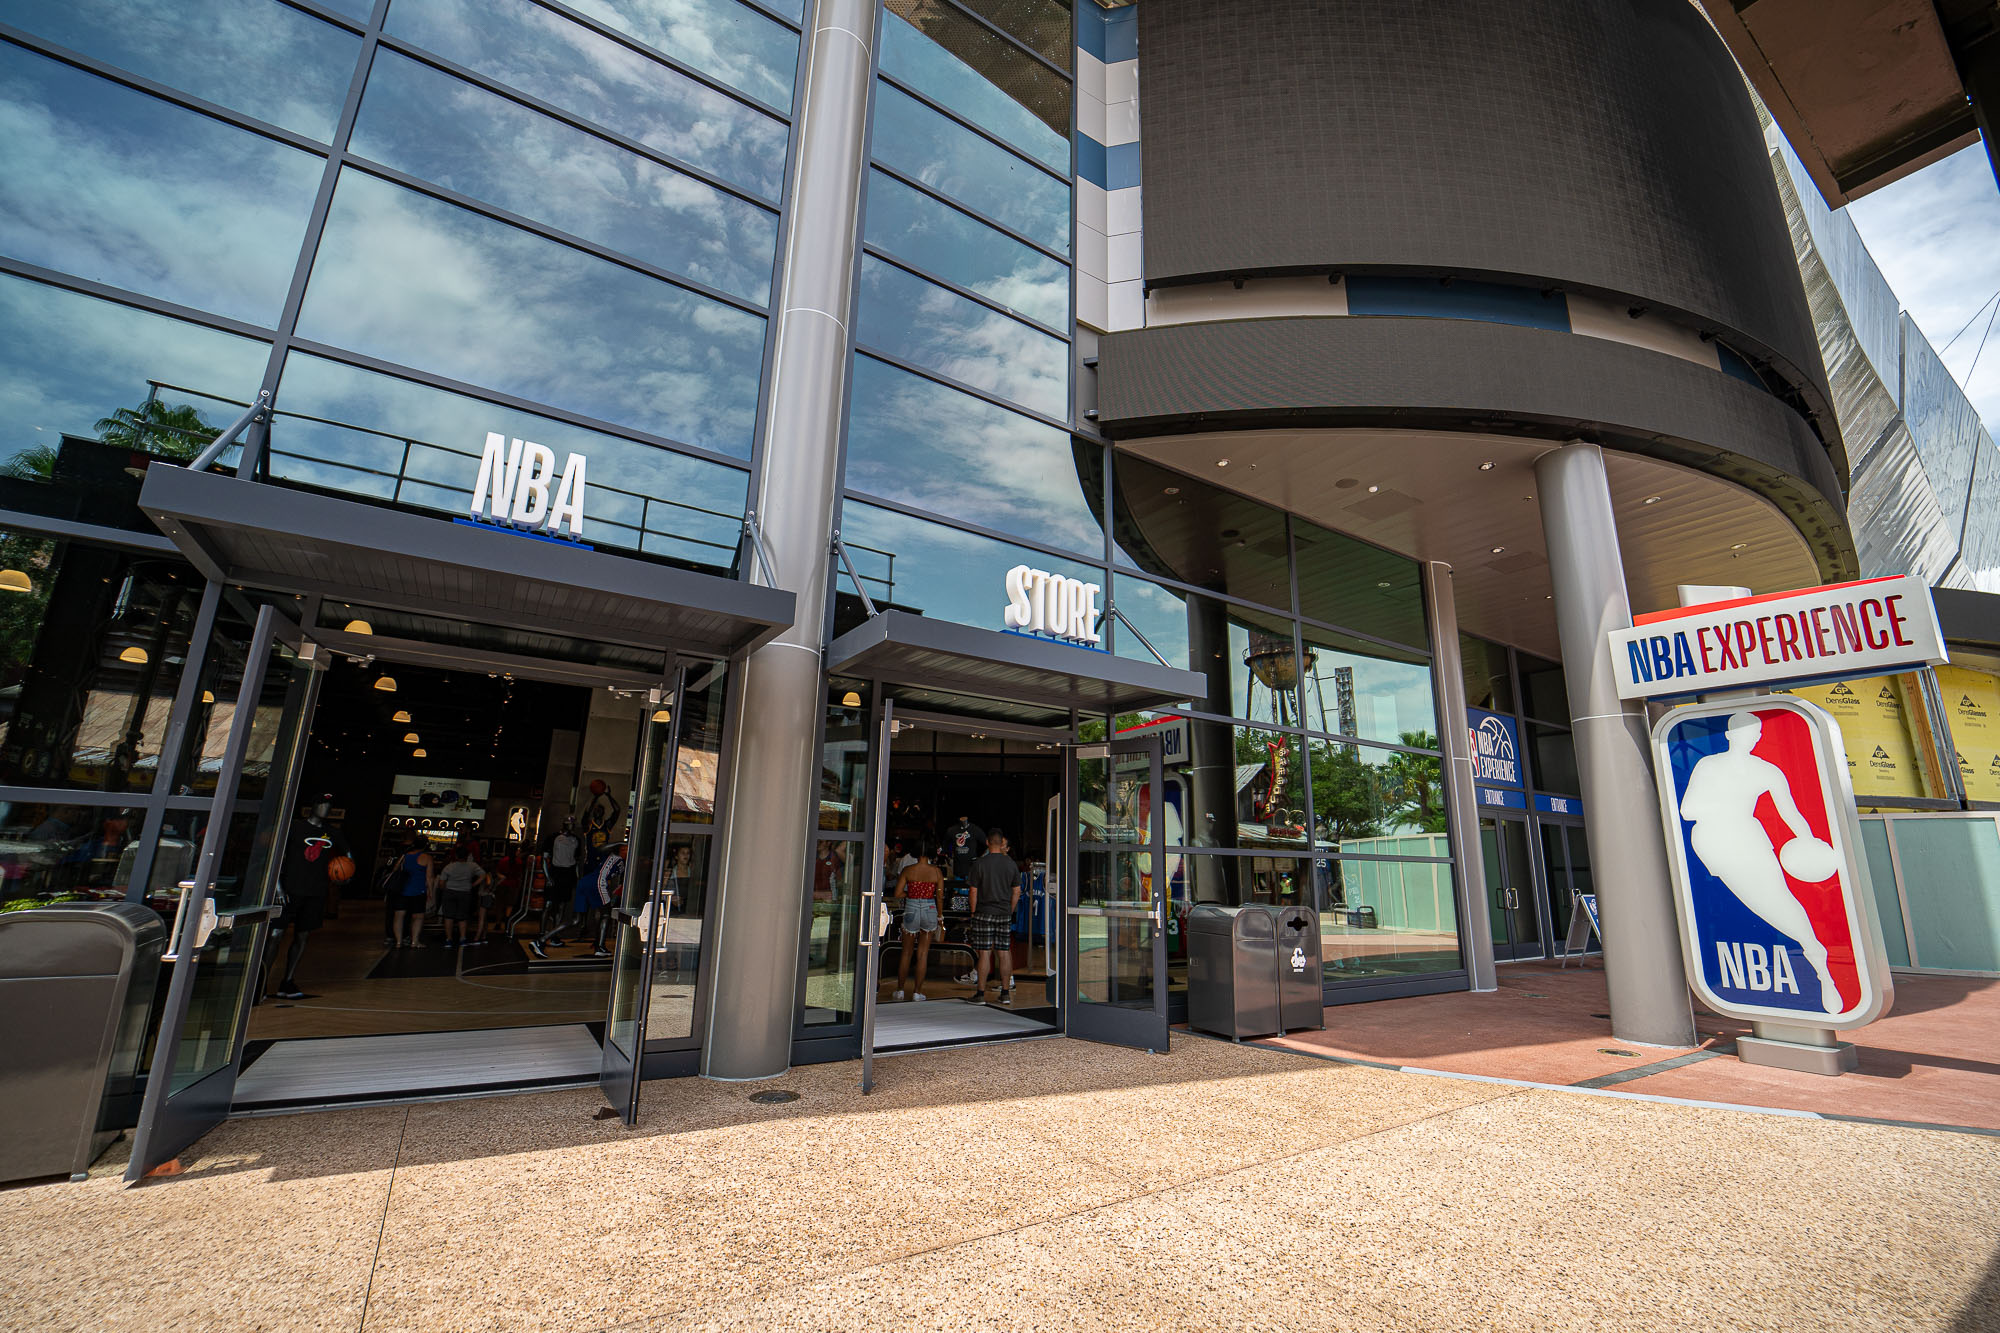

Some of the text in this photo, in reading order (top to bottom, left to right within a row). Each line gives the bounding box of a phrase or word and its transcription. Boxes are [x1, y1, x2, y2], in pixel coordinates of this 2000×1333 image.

[470, 431, 587, 541] NBA
[1004, 564, 1101, 644] STORE
[1626, 594, 1914, 685] NBA EXPERIENCE
[1825, 697, 1860, 705] DensGlass
[1477, 730, 1494, 756] NBA
[1480, 756, 1517, 782] EXPERIENCE
[1869, 760, 1896, 769] DensGlass
[1960, 766, 1975, 775] Glass
[1484, 789, 1505, 806] ENTRANCE
[1550, 797, 1569, 813] ENTRANCE
[1316, 858, 1327, 868] 25
[1716, 941, 1800, 995] NBA
